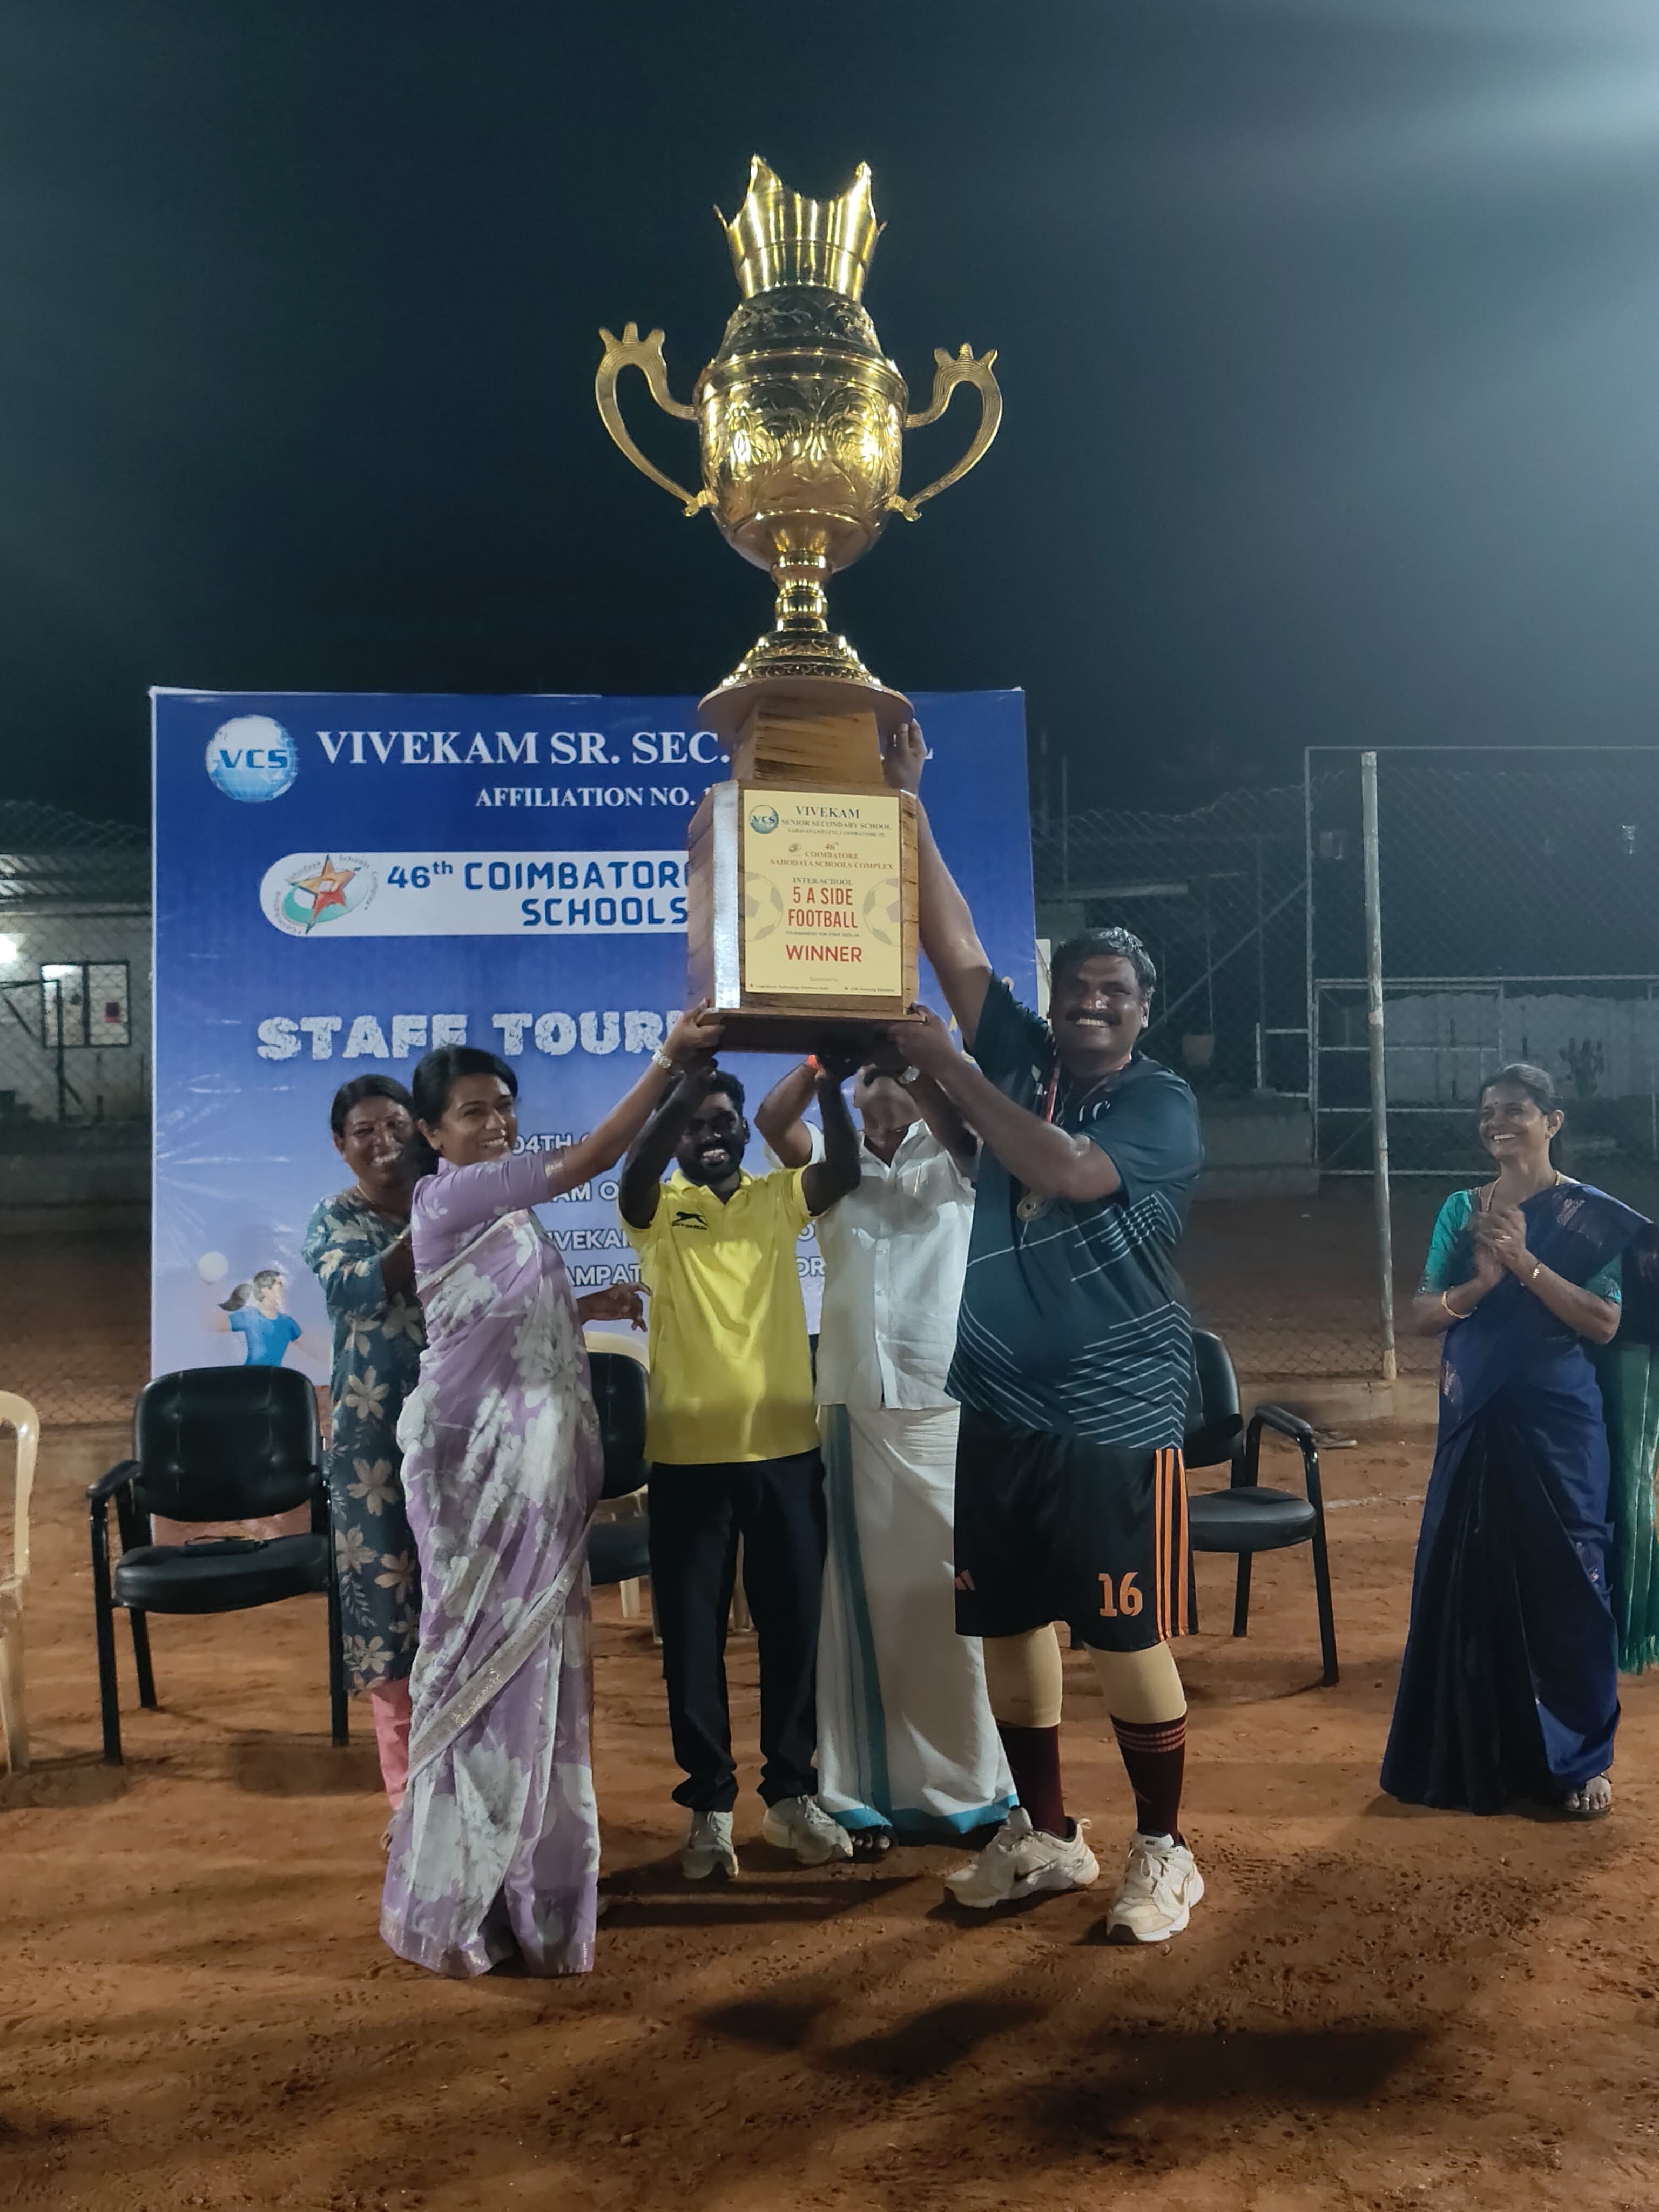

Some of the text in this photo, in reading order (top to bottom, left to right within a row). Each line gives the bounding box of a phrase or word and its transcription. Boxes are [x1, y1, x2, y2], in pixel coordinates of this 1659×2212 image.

[316, 731, 730, 764] VIVEKAM SR. SEC.
[218, 748, 289, 769] VCS
[475, 787, 643, 807] AFFILIATION
[650, 787, 696, 806] NO.
[752, 815, 775, 824] VCS
[795, 806, 860, 819] VIVEKAM
[812, 820, 858, 829] SECONDARY
[770, 858, 813, 866] SAHODAYA
[805, 851, 859, 860] COIMBATORE
[387, 860, 688, 891] 46th COIMBATOR
[793, 876, 853, 885] INTER-SCHOOL
[793, 886, 853, 906] 5 A SIDE
[522, 896, 688, 927] SCHOOLS
[788, 909, 859, 928] FOOTBALL
[785, 944, 862, 962] WINNER
[257, 1013, 467, 1061] STAFF
[548, 1229, 632, 1250] VEKA
[1098, 1572, 1143, 1617] 16
